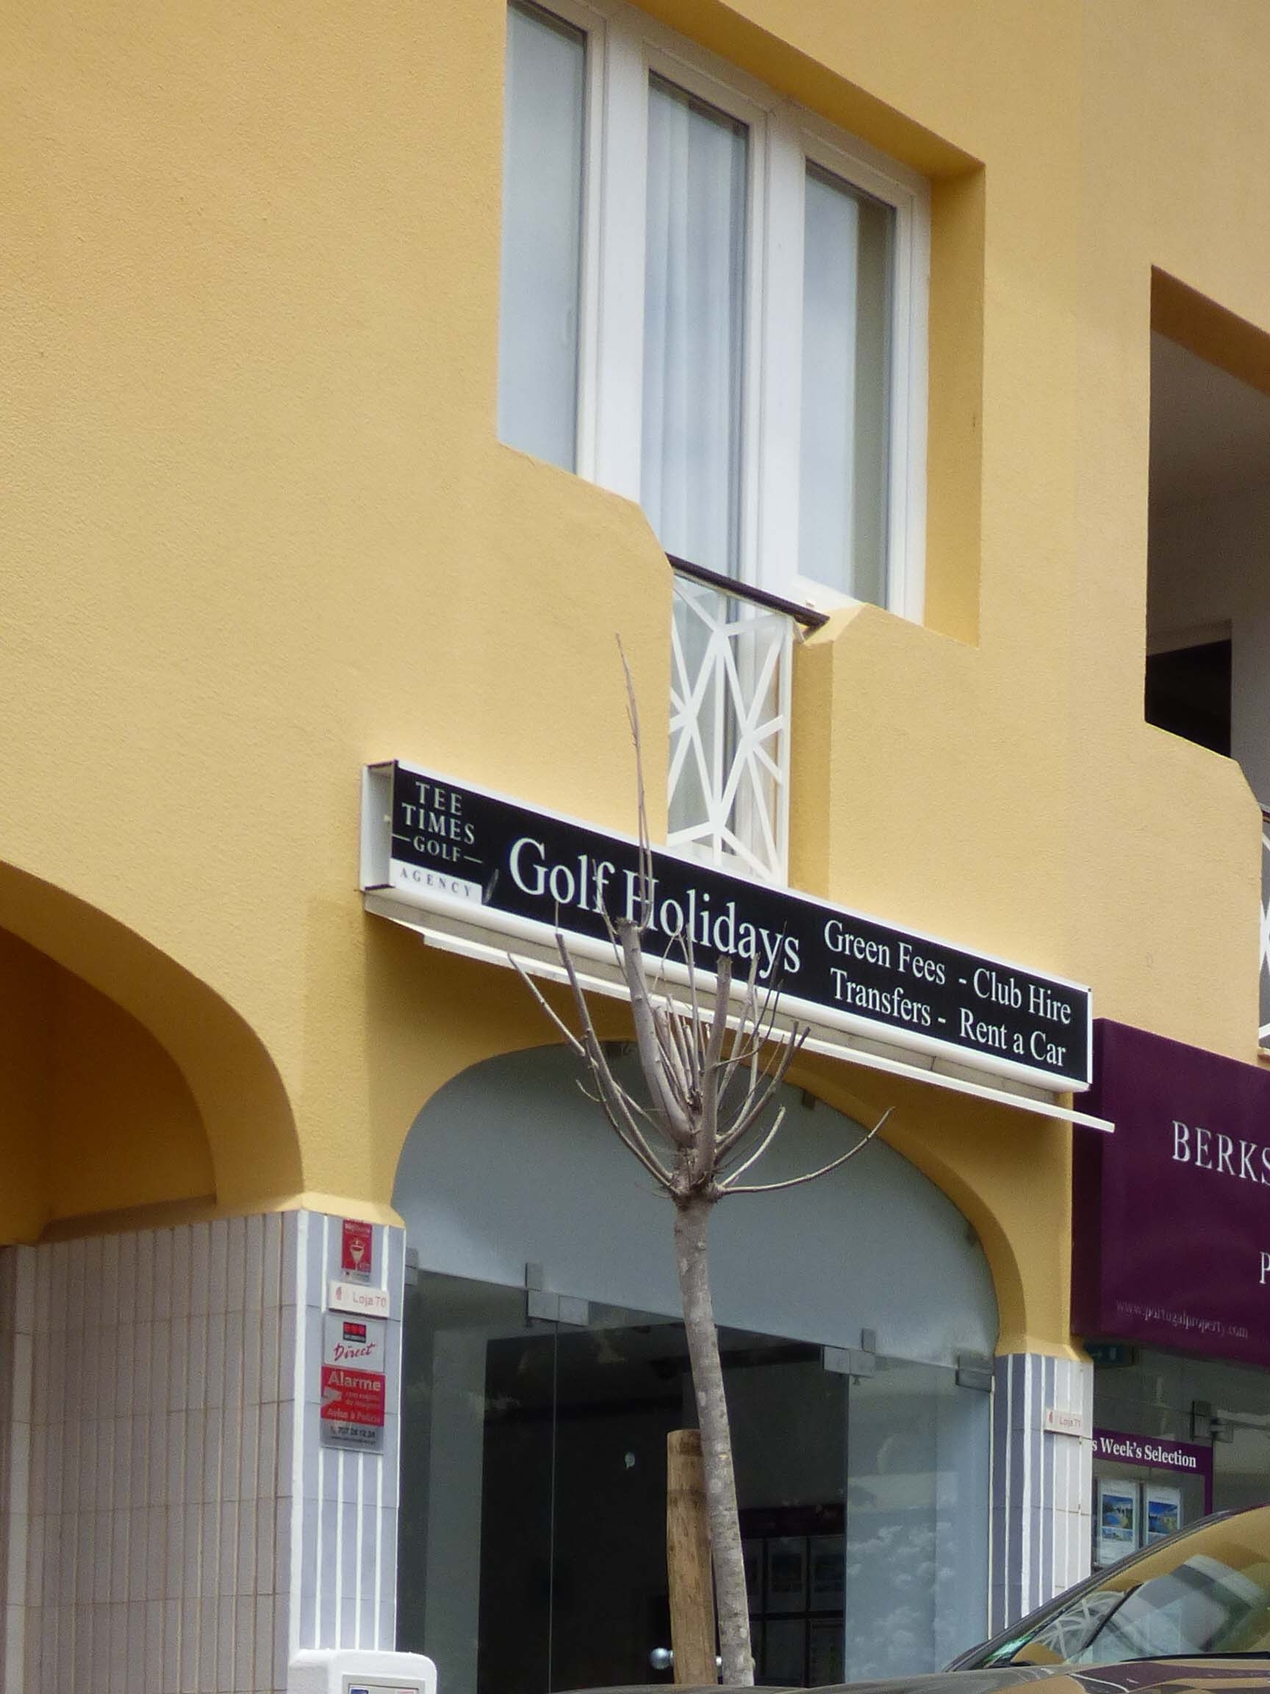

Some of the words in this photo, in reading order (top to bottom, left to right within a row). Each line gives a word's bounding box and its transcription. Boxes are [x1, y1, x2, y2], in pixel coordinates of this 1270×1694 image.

[415, 781, 463, 815] TEE
[402, 802, 475, 844] TIMES
[413, 835, 462, 862] GOLF
[400, 867, 471, 897] AGENCY
[509, 837, 615, 914] Golf
[623, 869, 800, 979] Holidays
[824, 920, 891, 968] Green
[898, 941, 946, 985] Fees
[973, 967, 1022, 1009] Club
[1028, 984, 1071, 1025] Hire
[830, 967, 931, 1027] Transfers
[959, 1007, 1007, 1050] Rent
[1013, 1033, 1024, 1054] a
[1030, 1031, 1066, 1067] Car
[352, 1291, 374, 1306] Loja
[333, 1342, 376, 1362] Direct
[328, 1370, 381, 1392] Alarme
[1100, 1437, 1142, 1459] Week's
[1144, 1445, 1197, 1468] Selection
